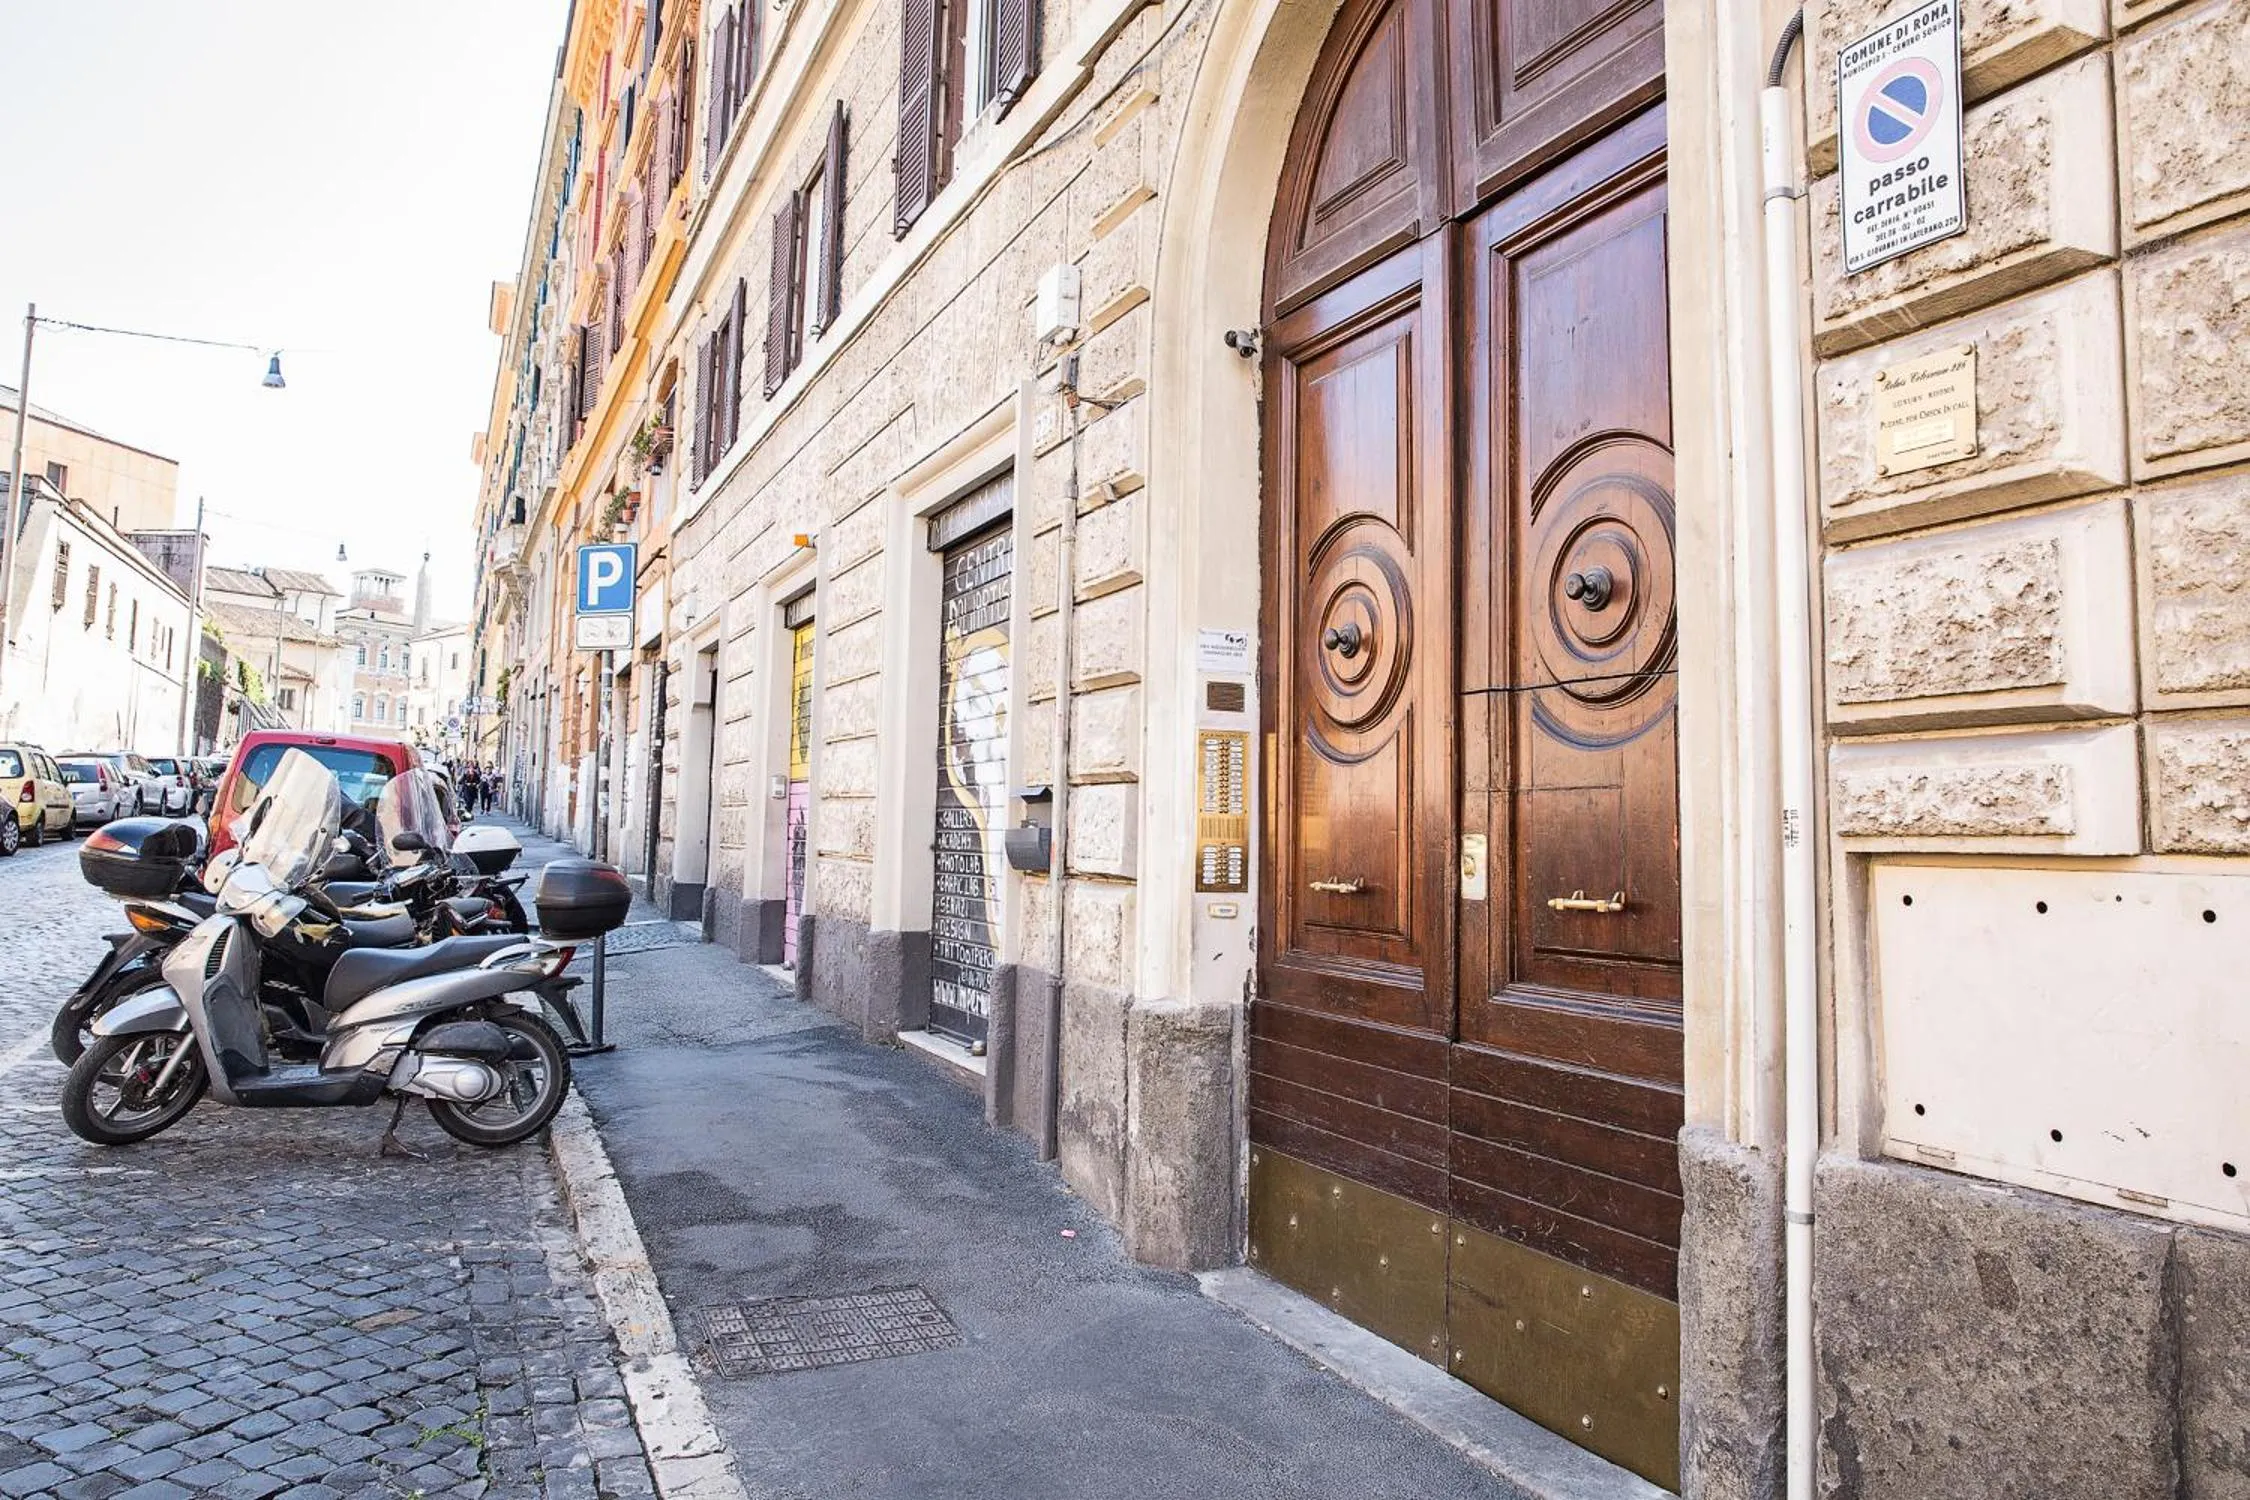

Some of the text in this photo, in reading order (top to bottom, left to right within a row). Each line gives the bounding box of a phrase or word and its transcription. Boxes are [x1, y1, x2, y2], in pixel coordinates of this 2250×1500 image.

[1844, 4, 1949, 68] COMUNE DI ROMA
[1892, 34, 1921, 54] CENTRO
[1853, 174, 1949, 225] carrabile
[1869, 156, 1930, 196] passo
[588, 551, 624, 606] P
